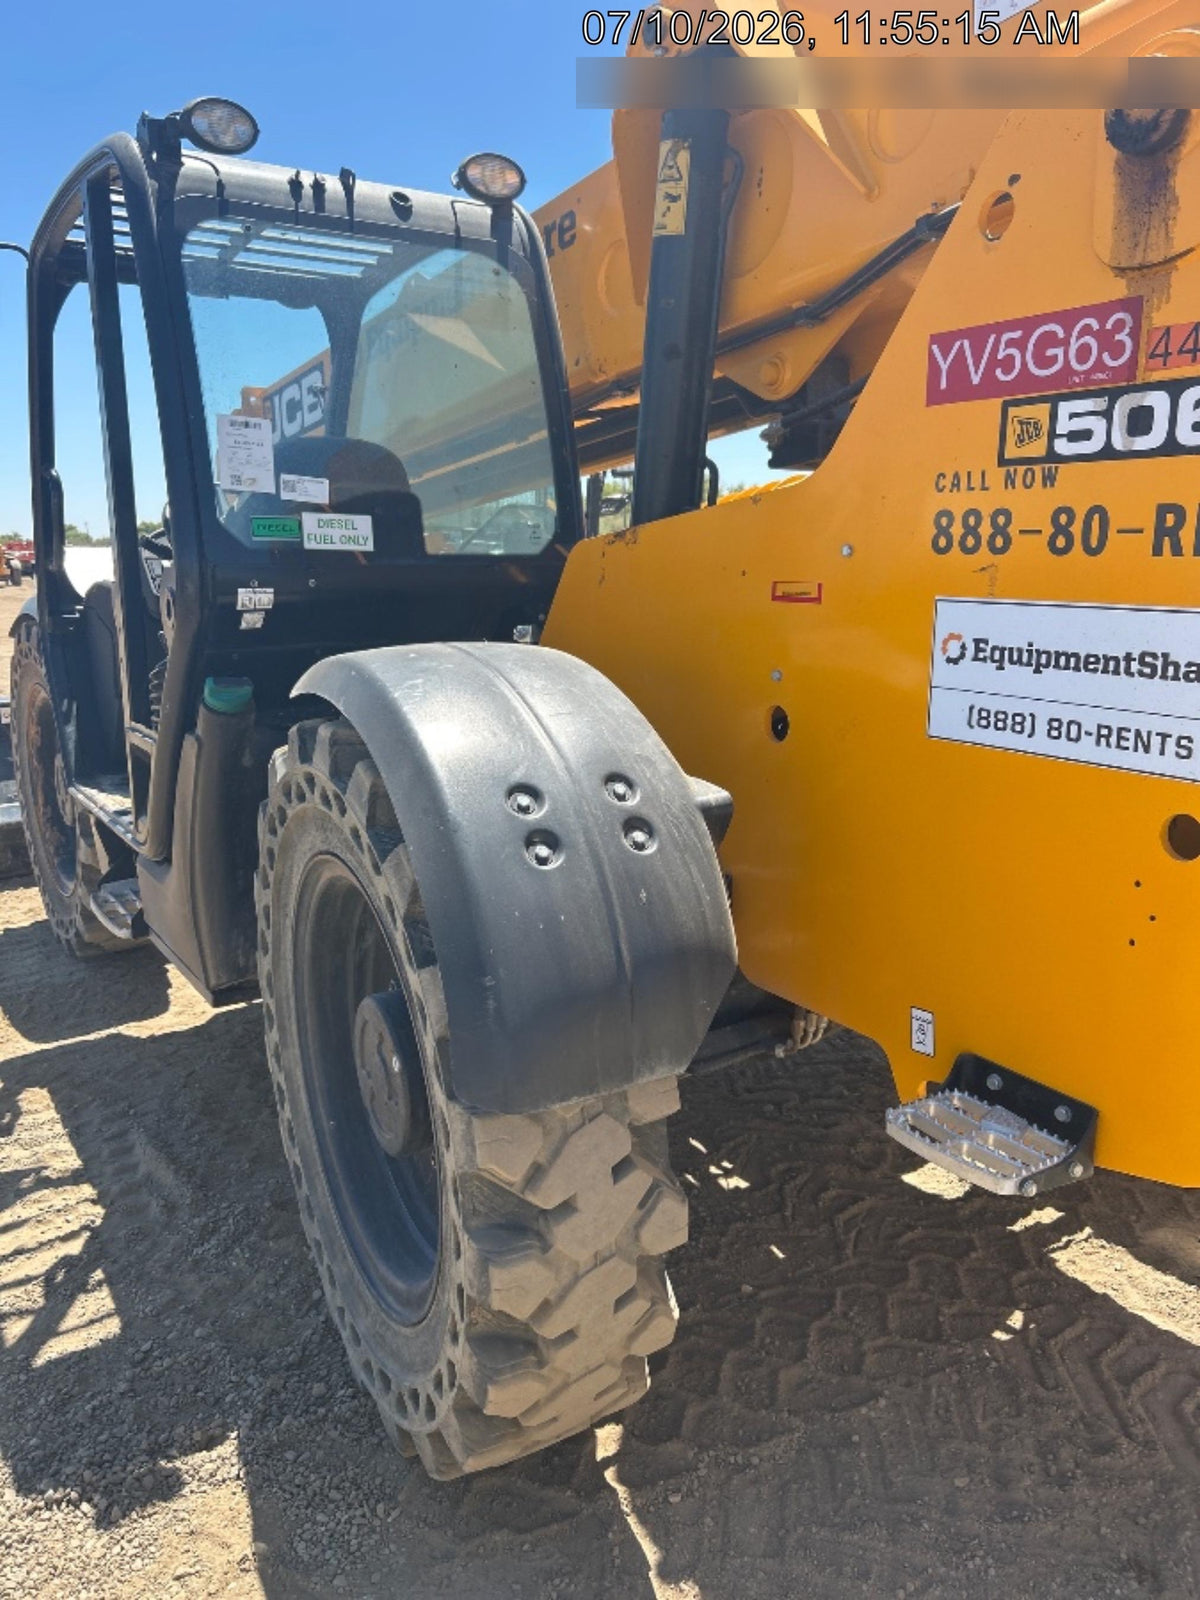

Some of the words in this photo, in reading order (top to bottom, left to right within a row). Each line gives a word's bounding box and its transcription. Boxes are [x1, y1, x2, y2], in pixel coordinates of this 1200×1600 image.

[930, 312, 1134, 391] YV5G63
[1148, 321, 1200, 367] 44
[1015, 418, 1044, 446] JCB
[1053, 385, 1200, 456] 506
[934, 469, 991, 493] CALL
[1004, 465, 1061, 490] NOW
[307, 533, 337, 545] FUEL
[338, 534, 369, 547] ONLY
[317, 518, 359, 531] DIESEL
[971, 637, 1200, 684] EquipmentSha
[966, 704, 1037, 739] (888)
[1046, 717, 1195, 761] 80-RENTS
